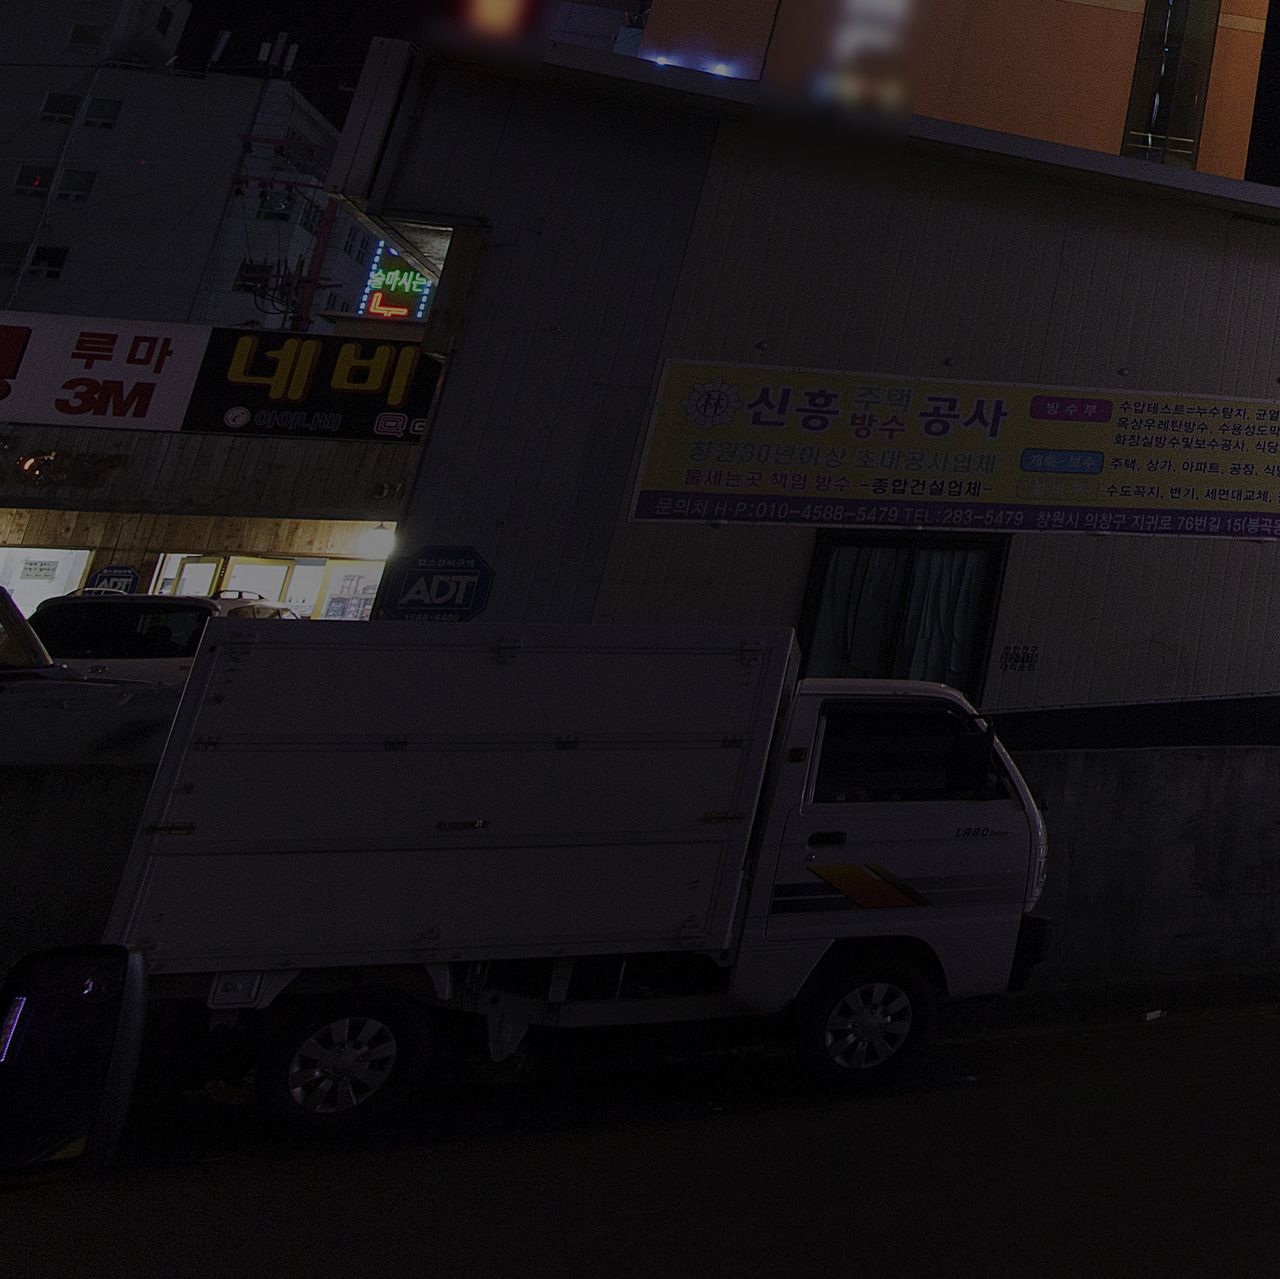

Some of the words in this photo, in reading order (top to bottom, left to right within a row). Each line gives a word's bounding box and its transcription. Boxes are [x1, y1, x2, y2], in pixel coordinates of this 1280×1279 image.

[370, 269, 427, 293] 술마시는
[72, 331, 173, 374] 루마
[227, 335, 422, 409] 네비
[55, 378, 157, 418] 3M
[747, 387, 840, 432] 신흥
[854, 387, 913, 413] 주택
[850, 413, 907, 439] 방수
[919, 396, 1008, 438] 공사
[656, 497, 708, 518] 문의처
[400, 574, 480, 605] ADT
